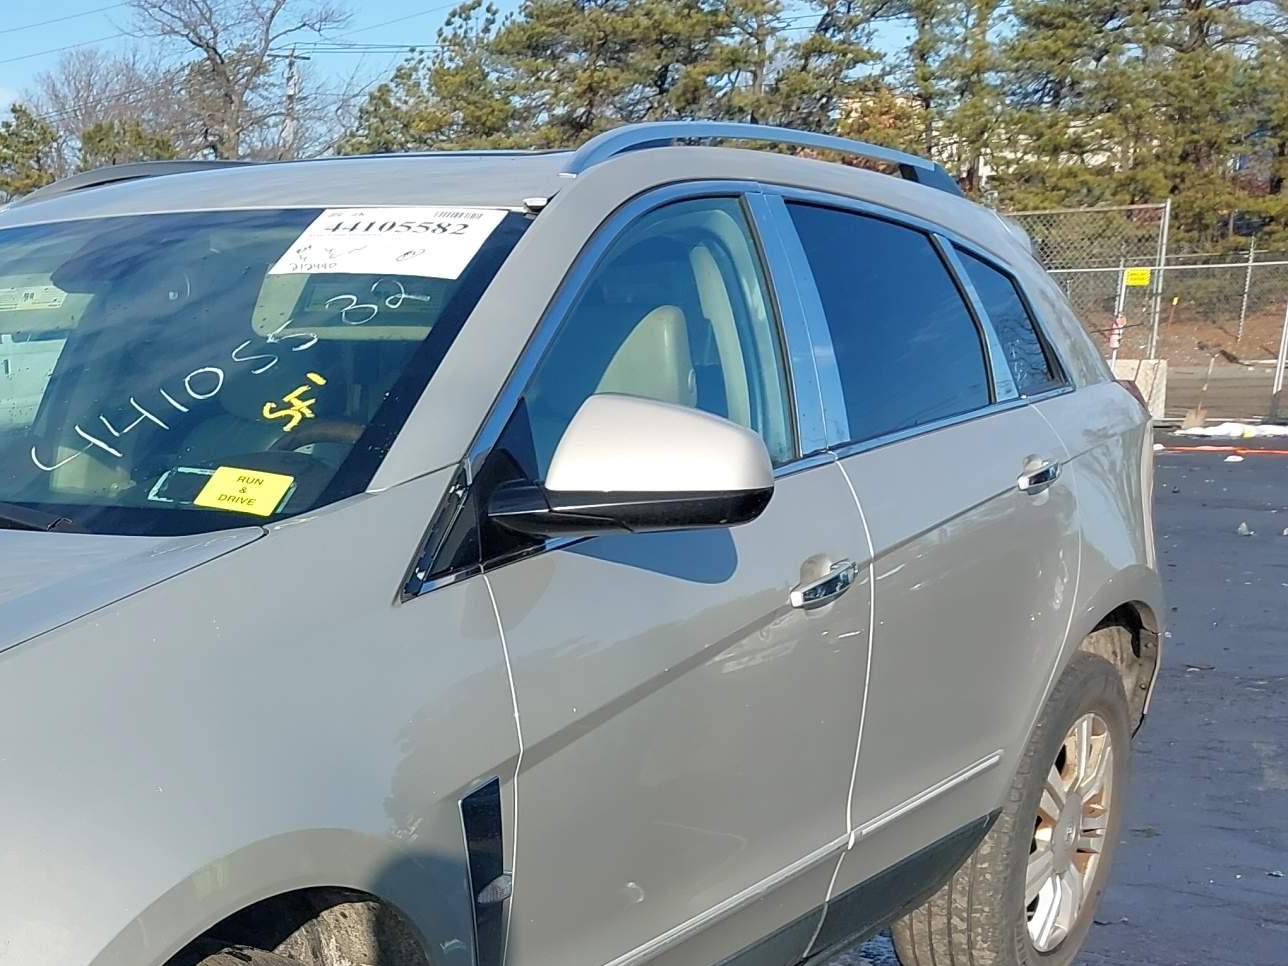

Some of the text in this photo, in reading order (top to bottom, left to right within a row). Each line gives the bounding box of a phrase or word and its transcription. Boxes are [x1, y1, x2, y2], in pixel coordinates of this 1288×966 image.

[325, 221, 469, 235] 44105582
[237, 476, 264, 485] RUN
[239, 486, 247, 494] &
[217, 494, 256, 505] DRIVE
